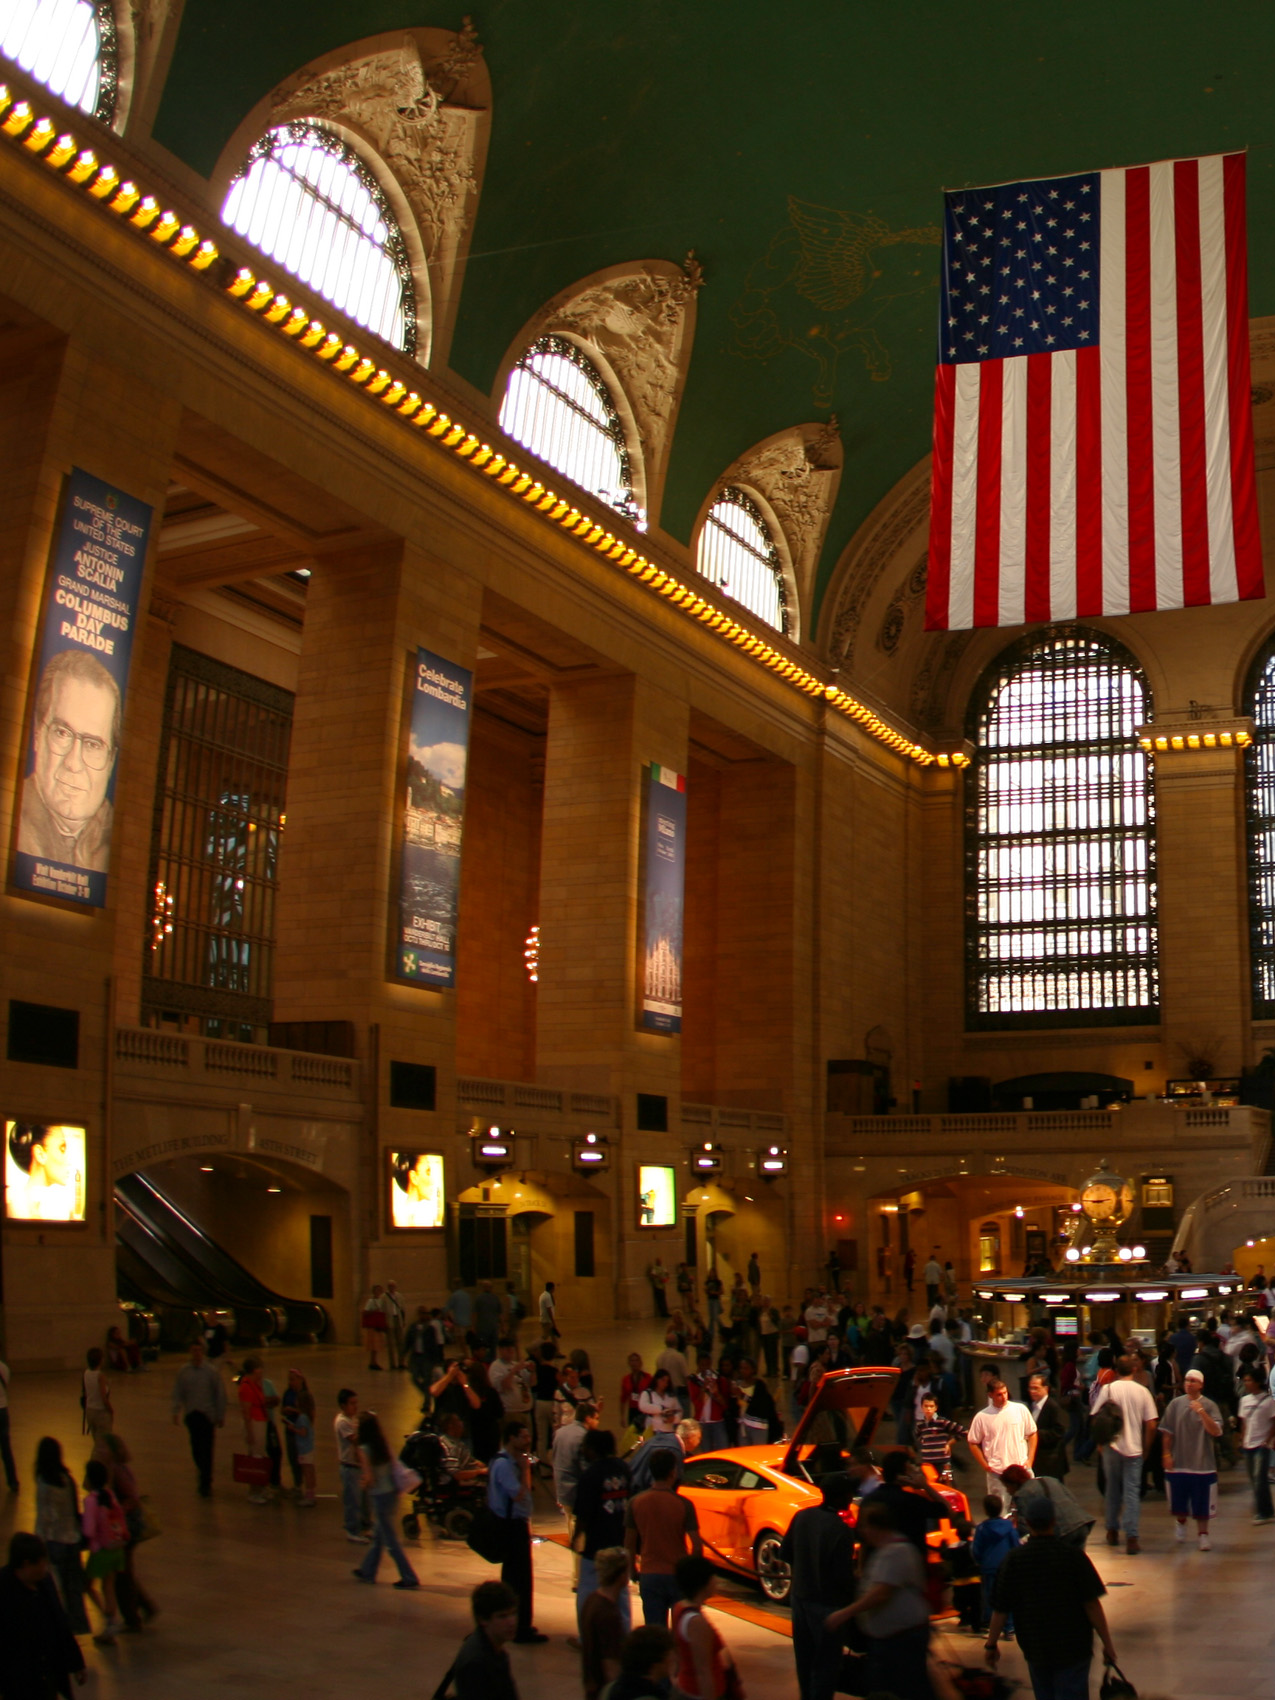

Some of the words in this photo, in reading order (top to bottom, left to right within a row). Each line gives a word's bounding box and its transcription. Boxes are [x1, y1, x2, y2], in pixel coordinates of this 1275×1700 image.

[73, 496, 115, 525] SUPREME
[115, 516, 144, 538] COURT
[92, 517, 105, 529] OF
[106, 524, 123, 540] THE
[73, 518, 105, 542] UNITED
[105, 534, 136, 557] STATES
[83, 541, 119, 565] JUSTICE
[74, 550, 125, 583] ANTONIN
[77, 564, 117, 593] SCALIA
[55, 589, 129, 632] COLUMBUS
[58, 575, 90, 596] GRAND
[90, 589, 131, 616] MARSHAL
[60, 621, 114, 656] PARADE
[76, 613, 104, 635] DAY
[417, 677, 466, 710] Lombardia
[418, 664, 464, 694] Celebrate
[413, 916, 441, 932] EXHIBIT
